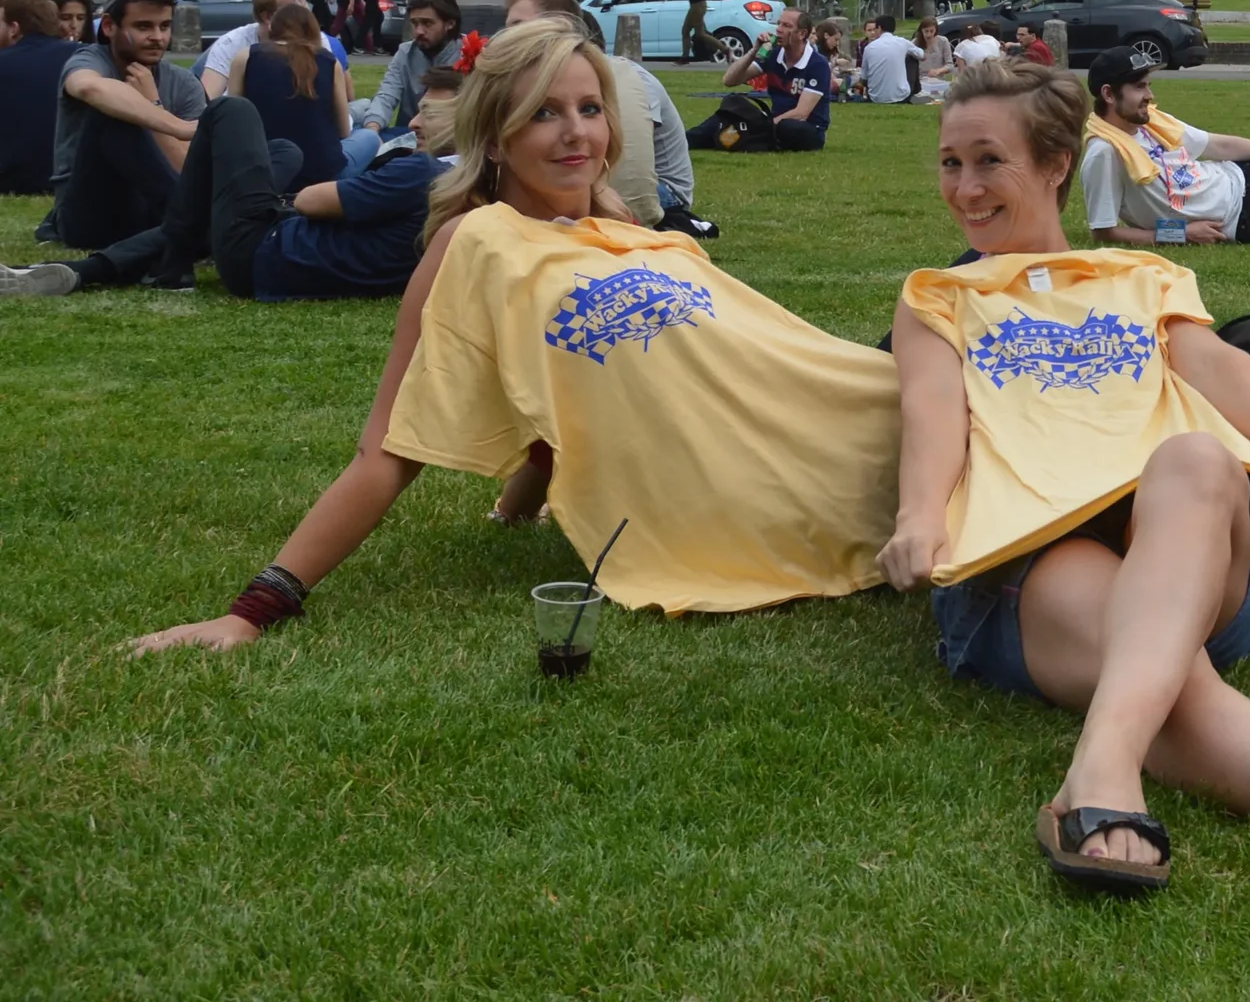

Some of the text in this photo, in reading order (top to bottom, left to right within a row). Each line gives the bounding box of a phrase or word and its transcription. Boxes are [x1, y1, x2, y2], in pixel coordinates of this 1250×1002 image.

[790, 77, 806, 95] 59
[583, 284, 648, 332] Wacky
[1001, 335, 1126, 360] Wacky Rally
